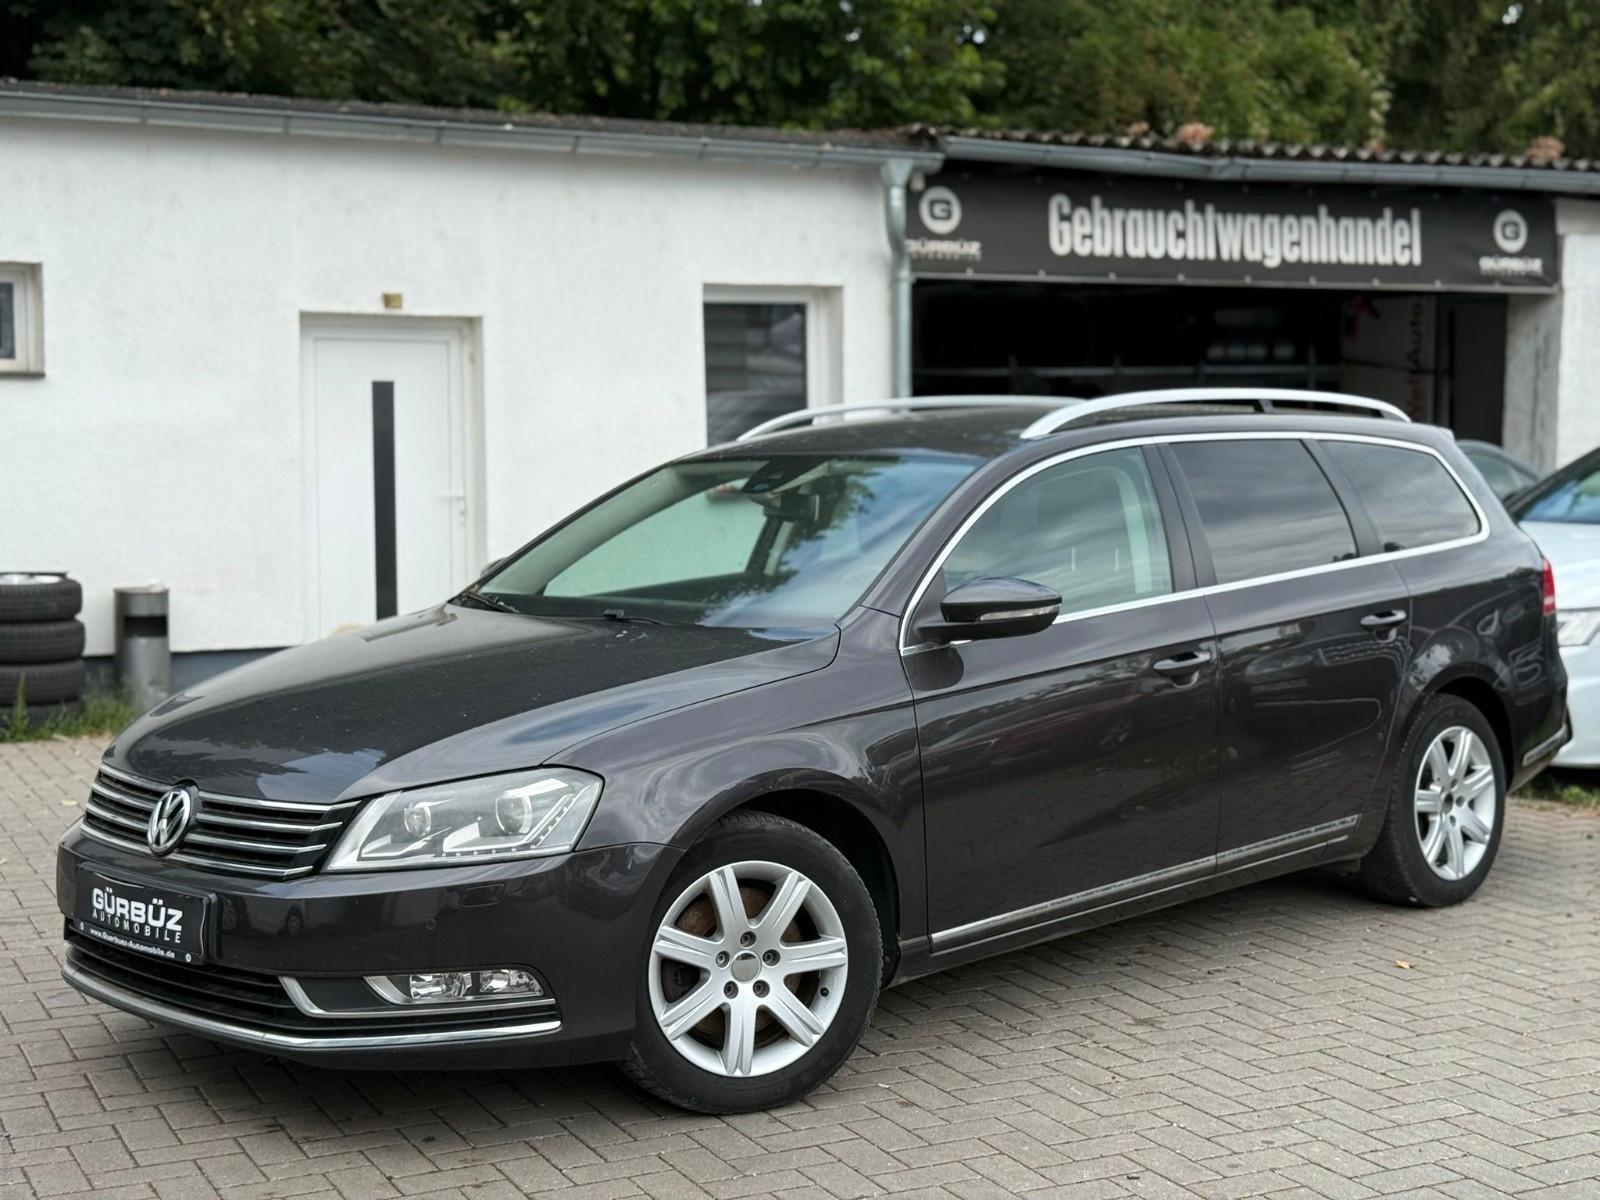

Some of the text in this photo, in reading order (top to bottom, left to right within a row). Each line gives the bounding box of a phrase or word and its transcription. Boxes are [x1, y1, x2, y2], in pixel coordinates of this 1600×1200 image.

[1048, 194, 1422, 268] Gebrauchtwagenhandel
[92, 887, 183, 931] GÜRBÜZ
[92, 911, 181, 943] AUTOMOBILE
